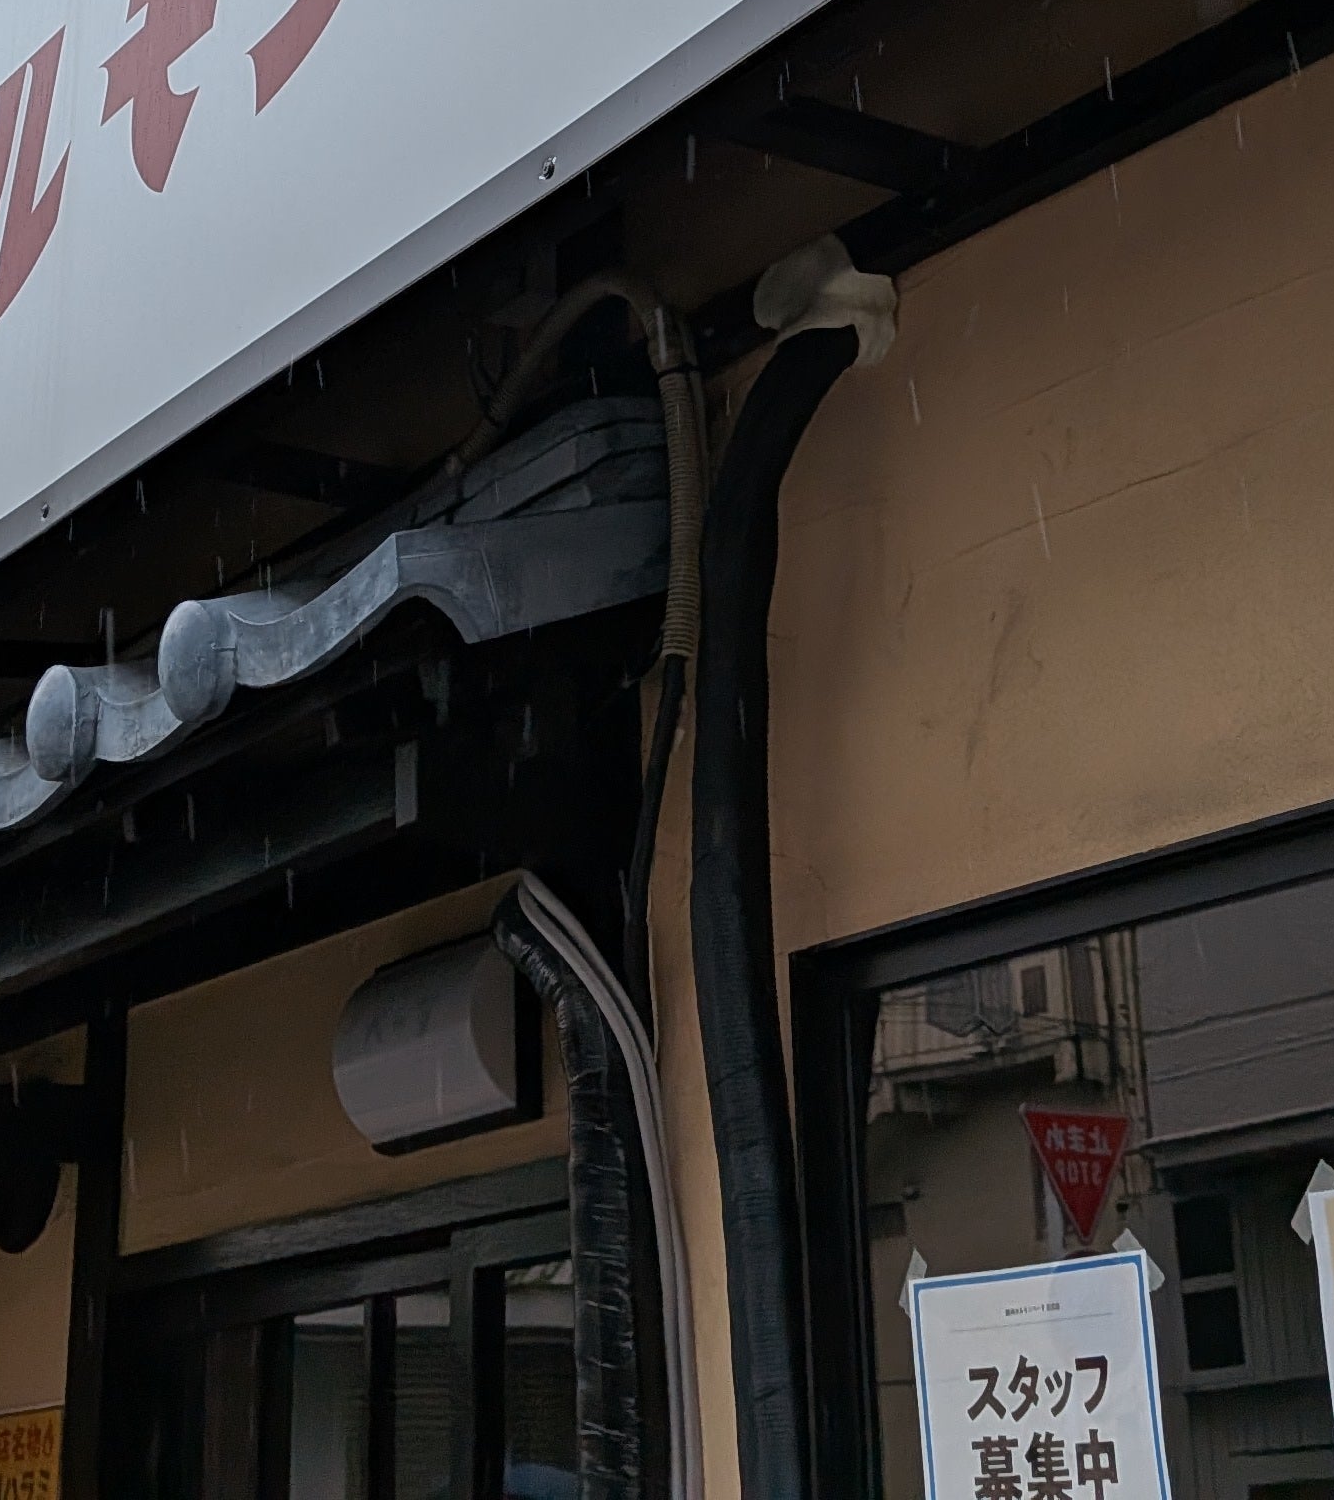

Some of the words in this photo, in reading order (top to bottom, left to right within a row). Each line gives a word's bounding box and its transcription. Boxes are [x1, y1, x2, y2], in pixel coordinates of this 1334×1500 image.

[966, 1354, 1109, 1422] スタッフ
[971, 1429, 1119, 1500] 募集中
